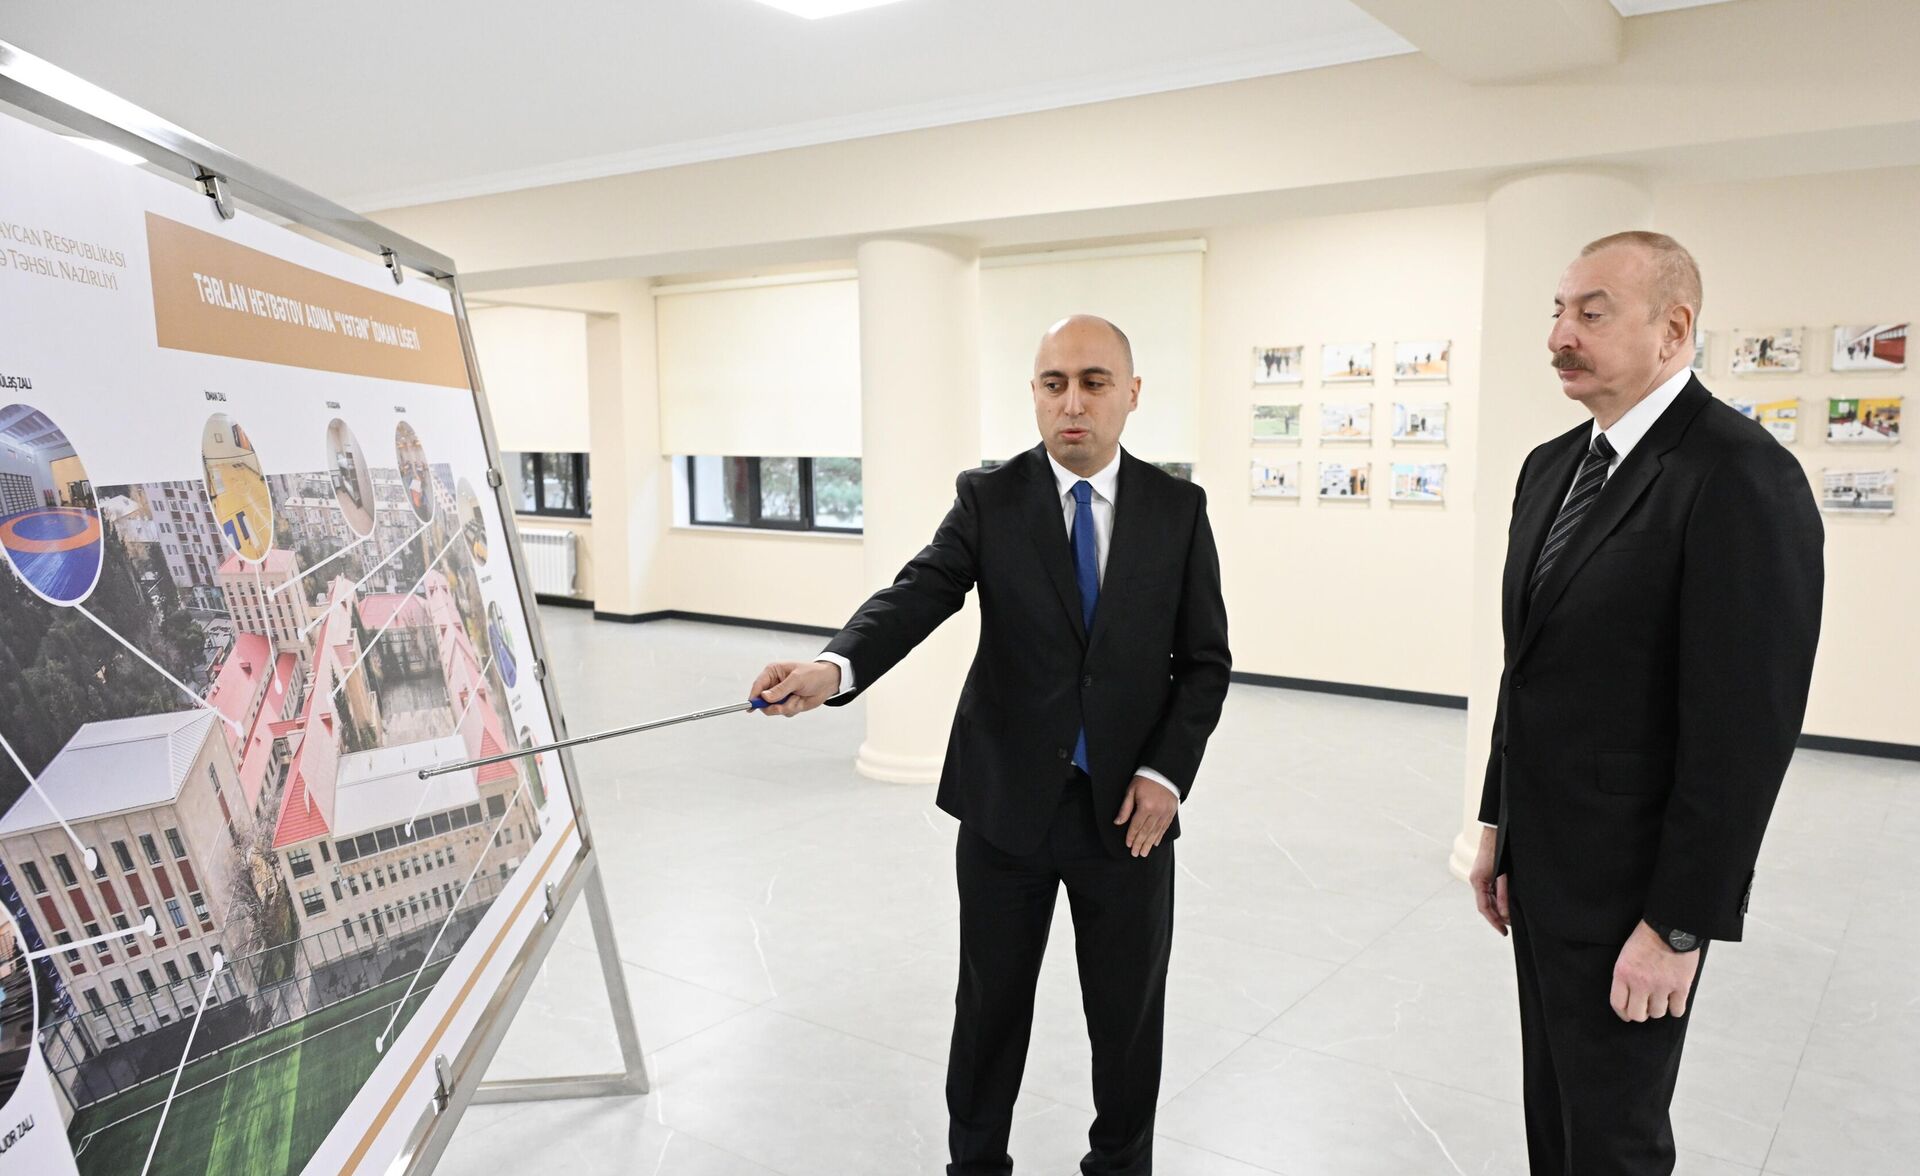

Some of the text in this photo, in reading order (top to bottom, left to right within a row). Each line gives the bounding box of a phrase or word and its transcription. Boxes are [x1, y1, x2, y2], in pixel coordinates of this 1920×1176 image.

[7, 248, 59, 278] TƏHSİL
[58, 260, 119, 291] NAZİRLİYİ
[43, 230, 127, 268] RESPUBLİKASI
[193, 272, 249, 312] TƏRLAN
[247, 287, 305, 326] HEYBƏTOV
[305, 303, 337, 333] ADINA
